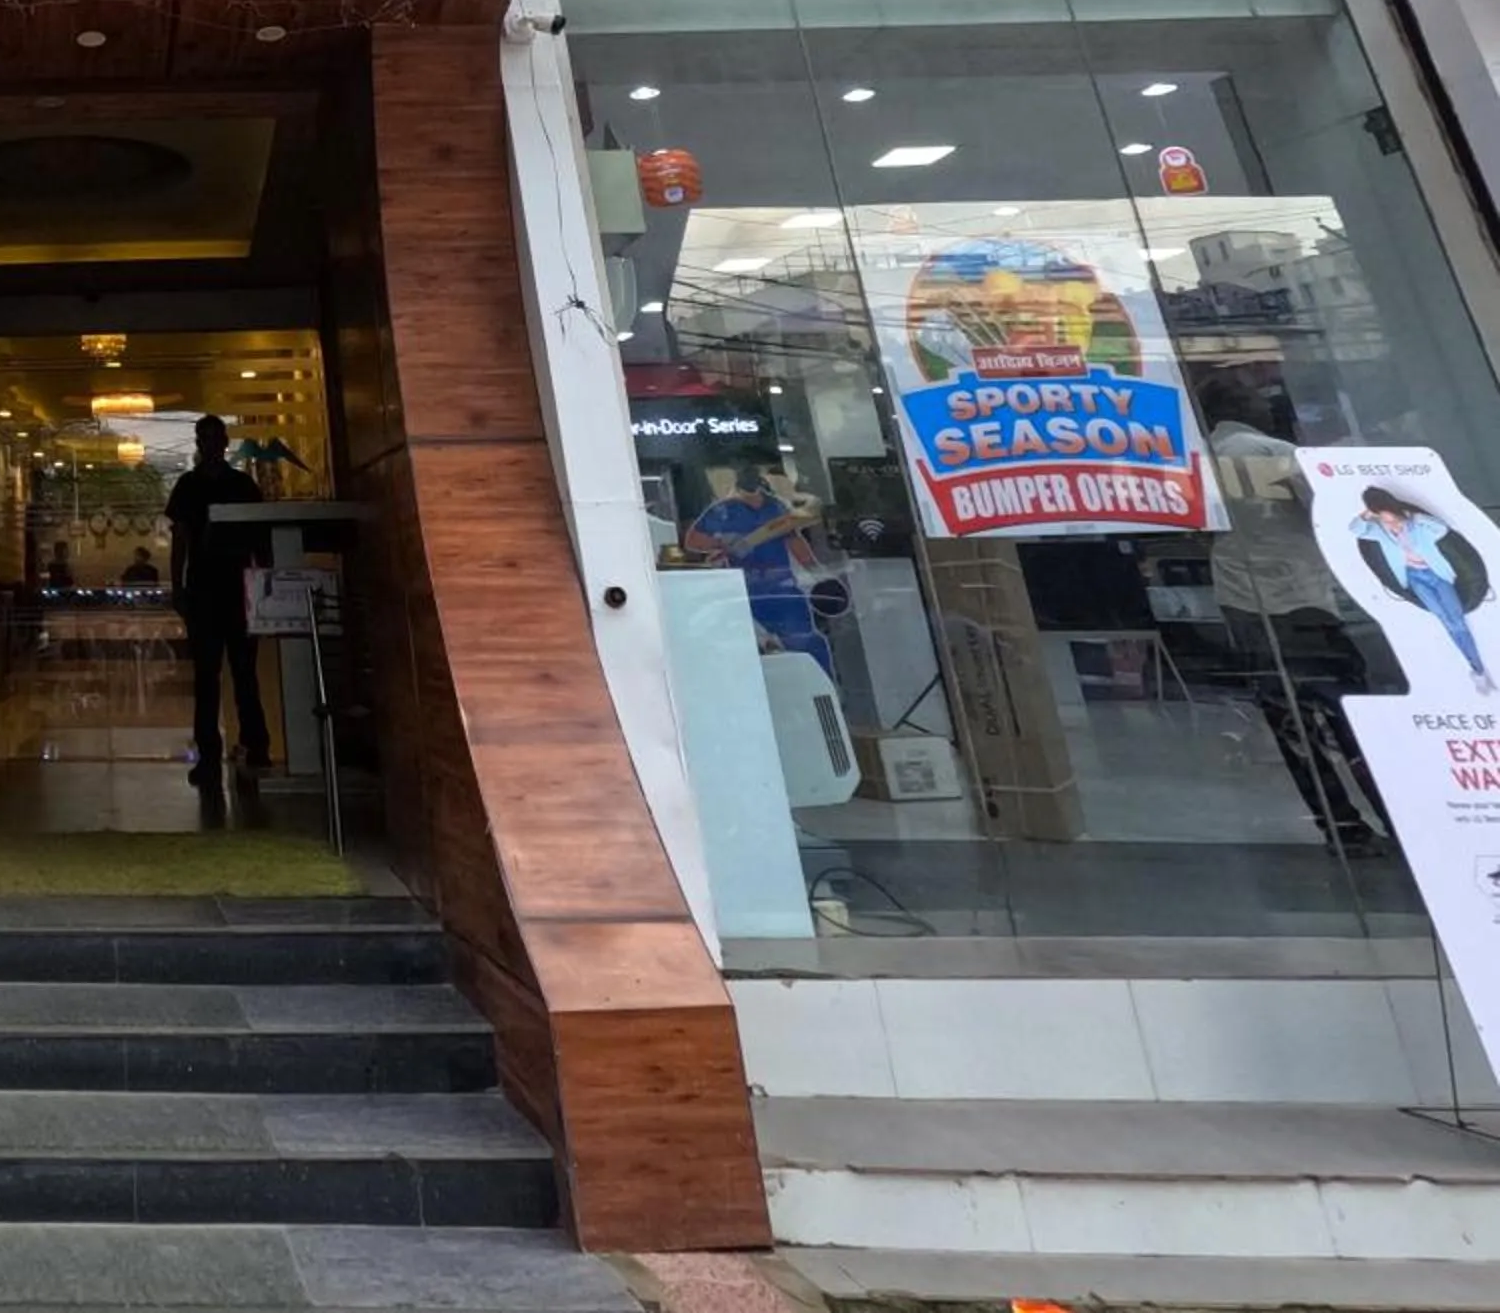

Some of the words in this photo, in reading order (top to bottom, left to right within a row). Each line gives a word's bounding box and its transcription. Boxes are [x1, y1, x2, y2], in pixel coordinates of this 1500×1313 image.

[947, 383, 1134, 421] SPORTY
[707, 417, 760, 434] Series
[934, 416, 1177, 466] SEASON
[951, 474, 1077, 522] BUMPER
[1077, 473, 1190, 516] OFFERS
[1412, 713, 1472, 731] PEACE
[1473, 713, 1497, 731] OF
[1445, 740, 1500, 763] EXT
[1450, 767, 1500, 791] WA
